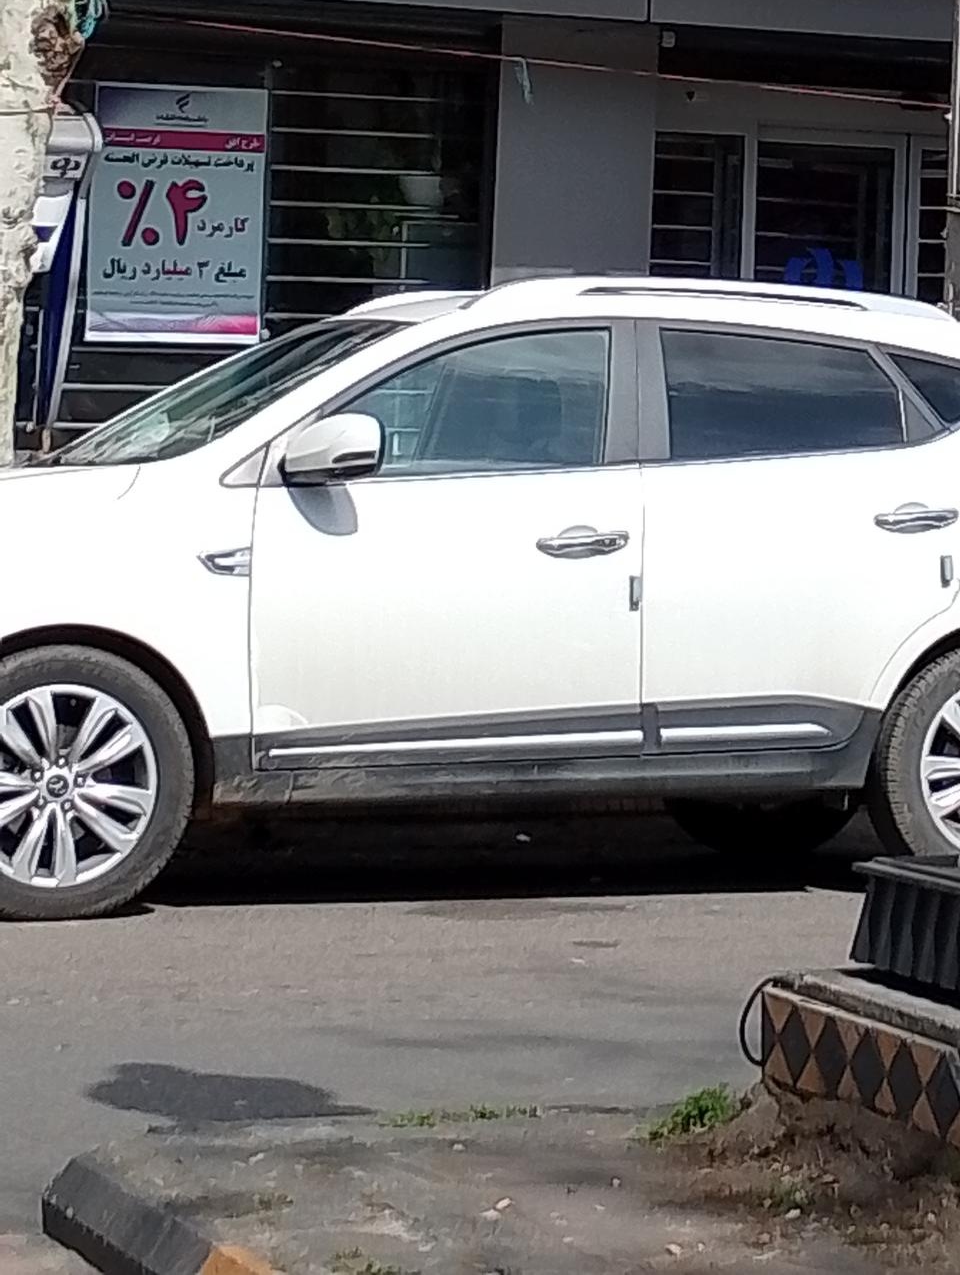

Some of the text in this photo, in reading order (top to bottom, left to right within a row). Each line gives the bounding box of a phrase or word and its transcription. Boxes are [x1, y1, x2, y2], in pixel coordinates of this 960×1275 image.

[196, 217, 249, 238] کارمزد
[102, 257, 137, 281] ریال
[142, 259, 193, 281] میلیارد
[214, 261, 247, 283] مبلغ
